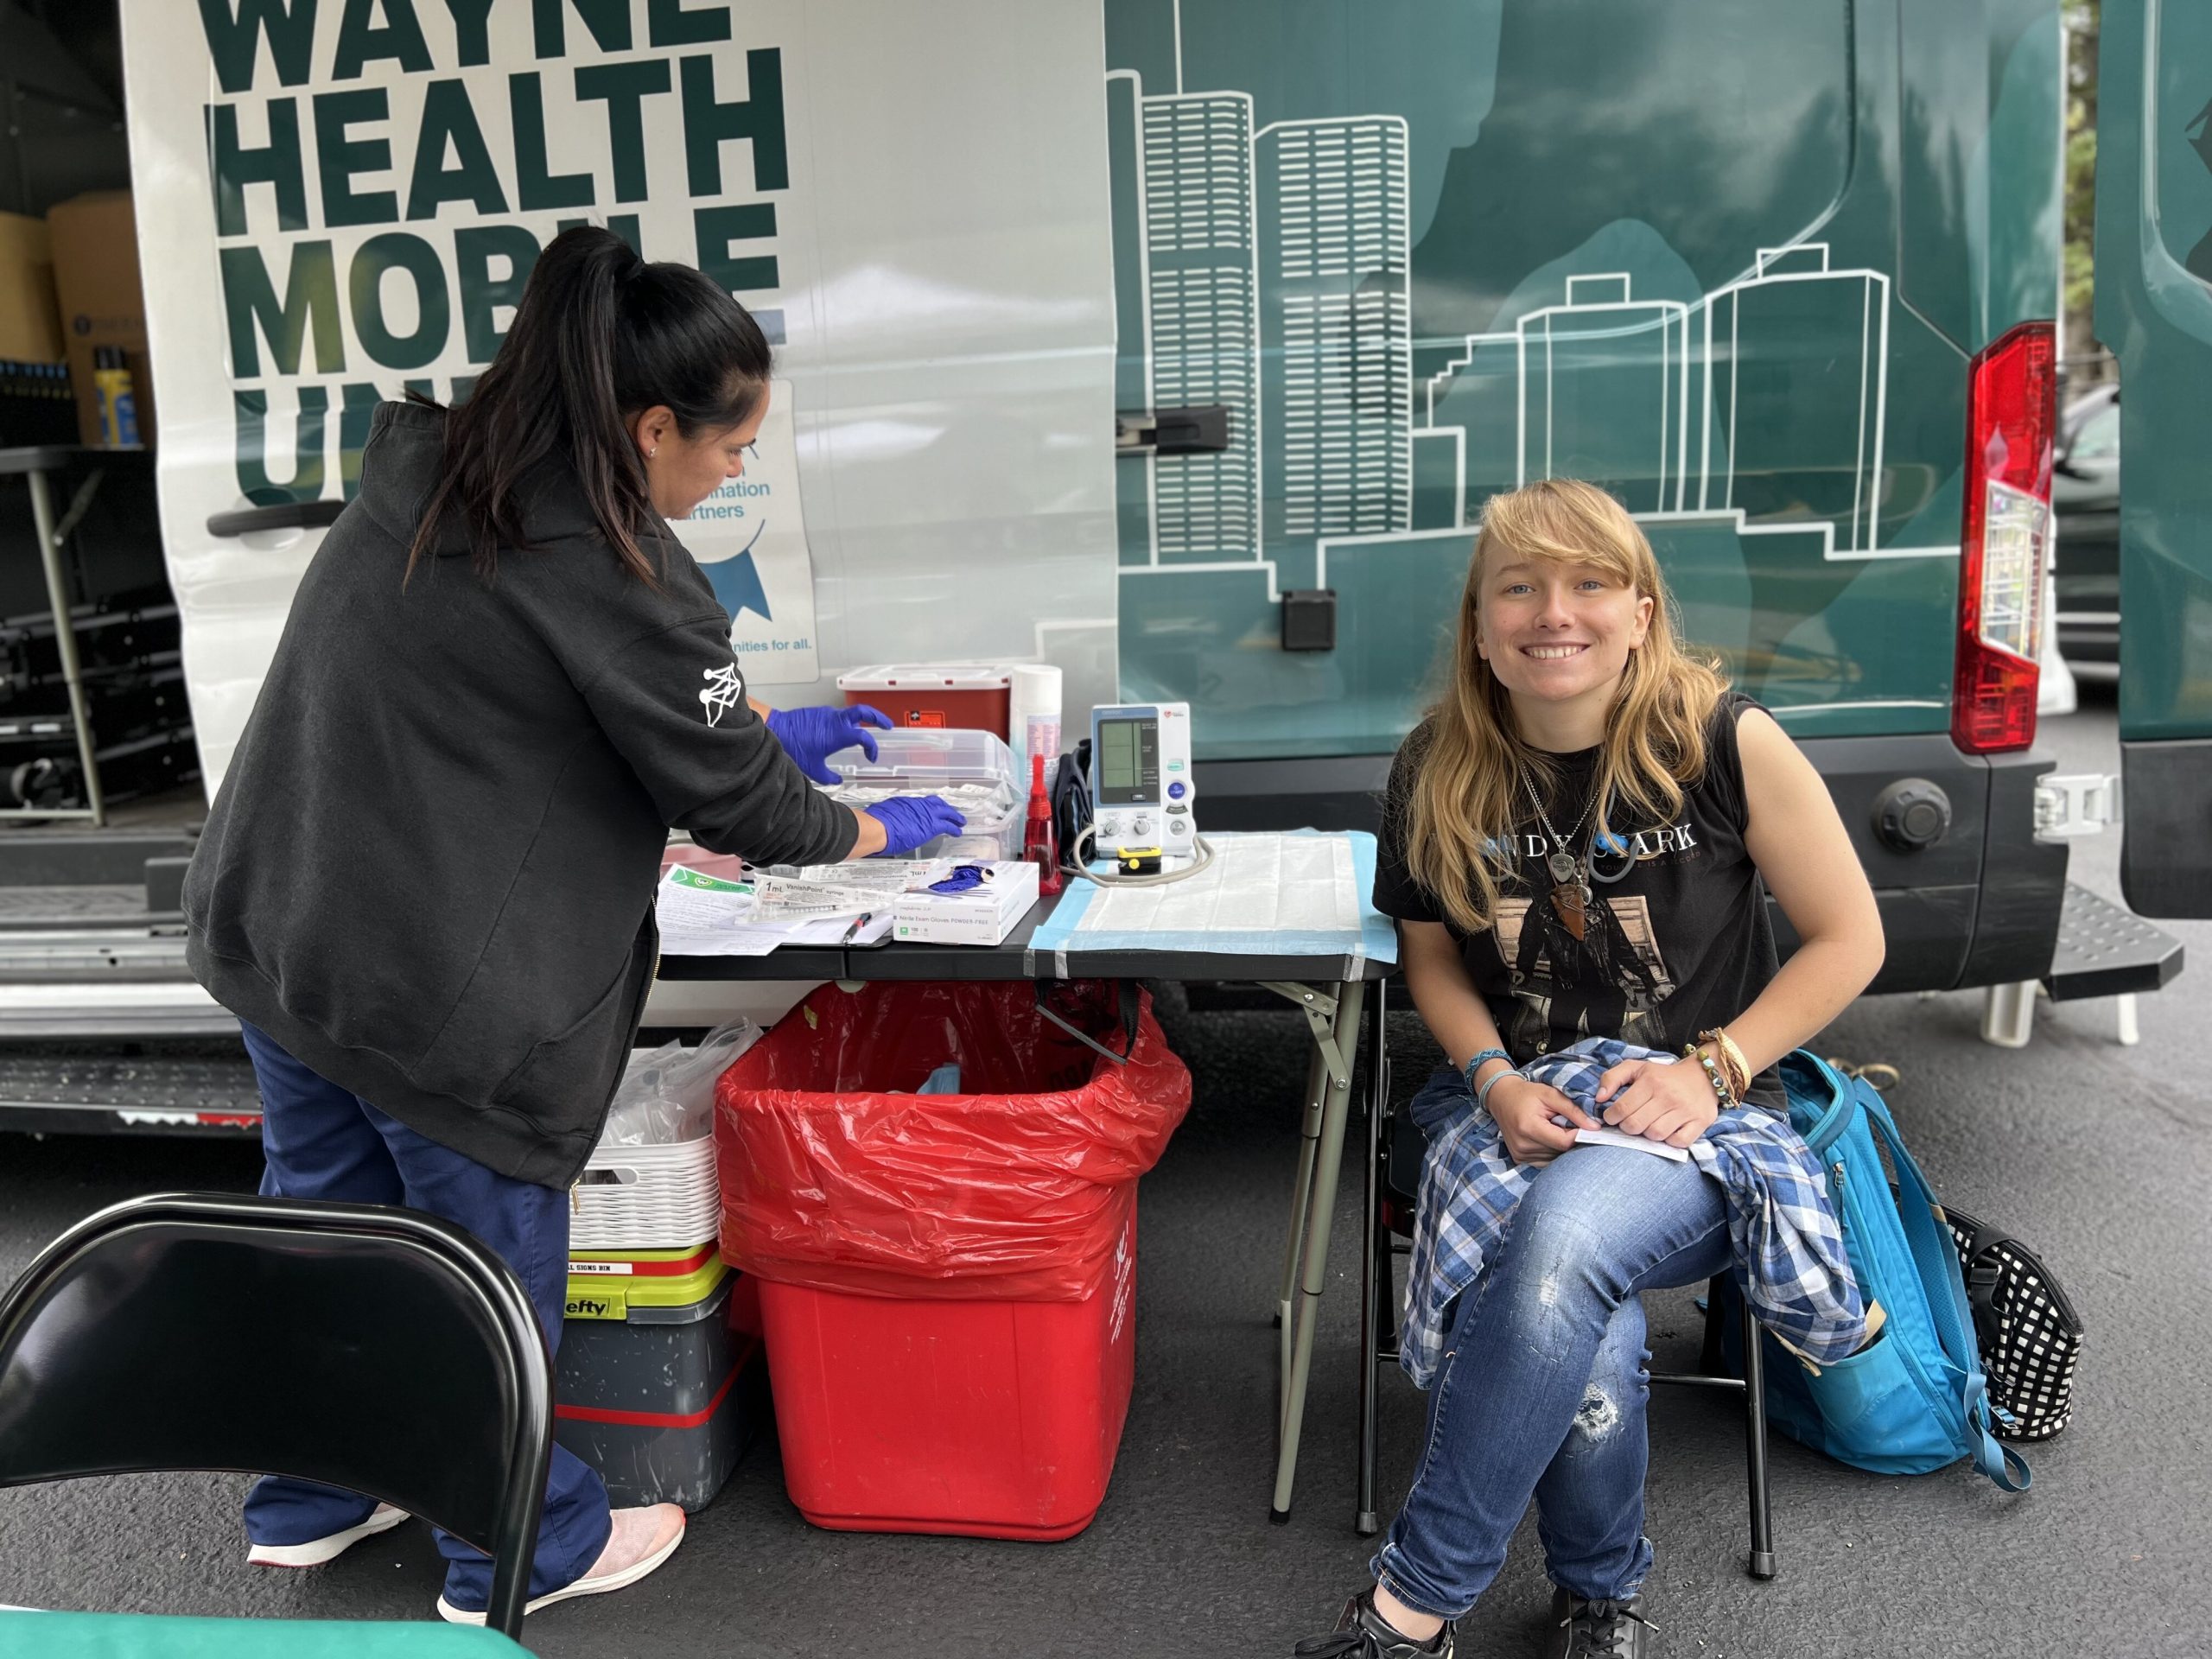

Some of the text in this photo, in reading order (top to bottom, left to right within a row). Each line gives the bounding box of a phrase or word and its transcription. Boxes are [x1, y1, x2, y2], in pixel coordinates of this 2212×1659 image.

[204, 47, 787, 236] HEALTH
[219, 202, 786, 378] MOBE
[772, 640, 789, 651] for
[793, 639, 811, 650] all.
[1594, 823, 1698, 858] ARK
[566, 1300, 606, 1315] efty
